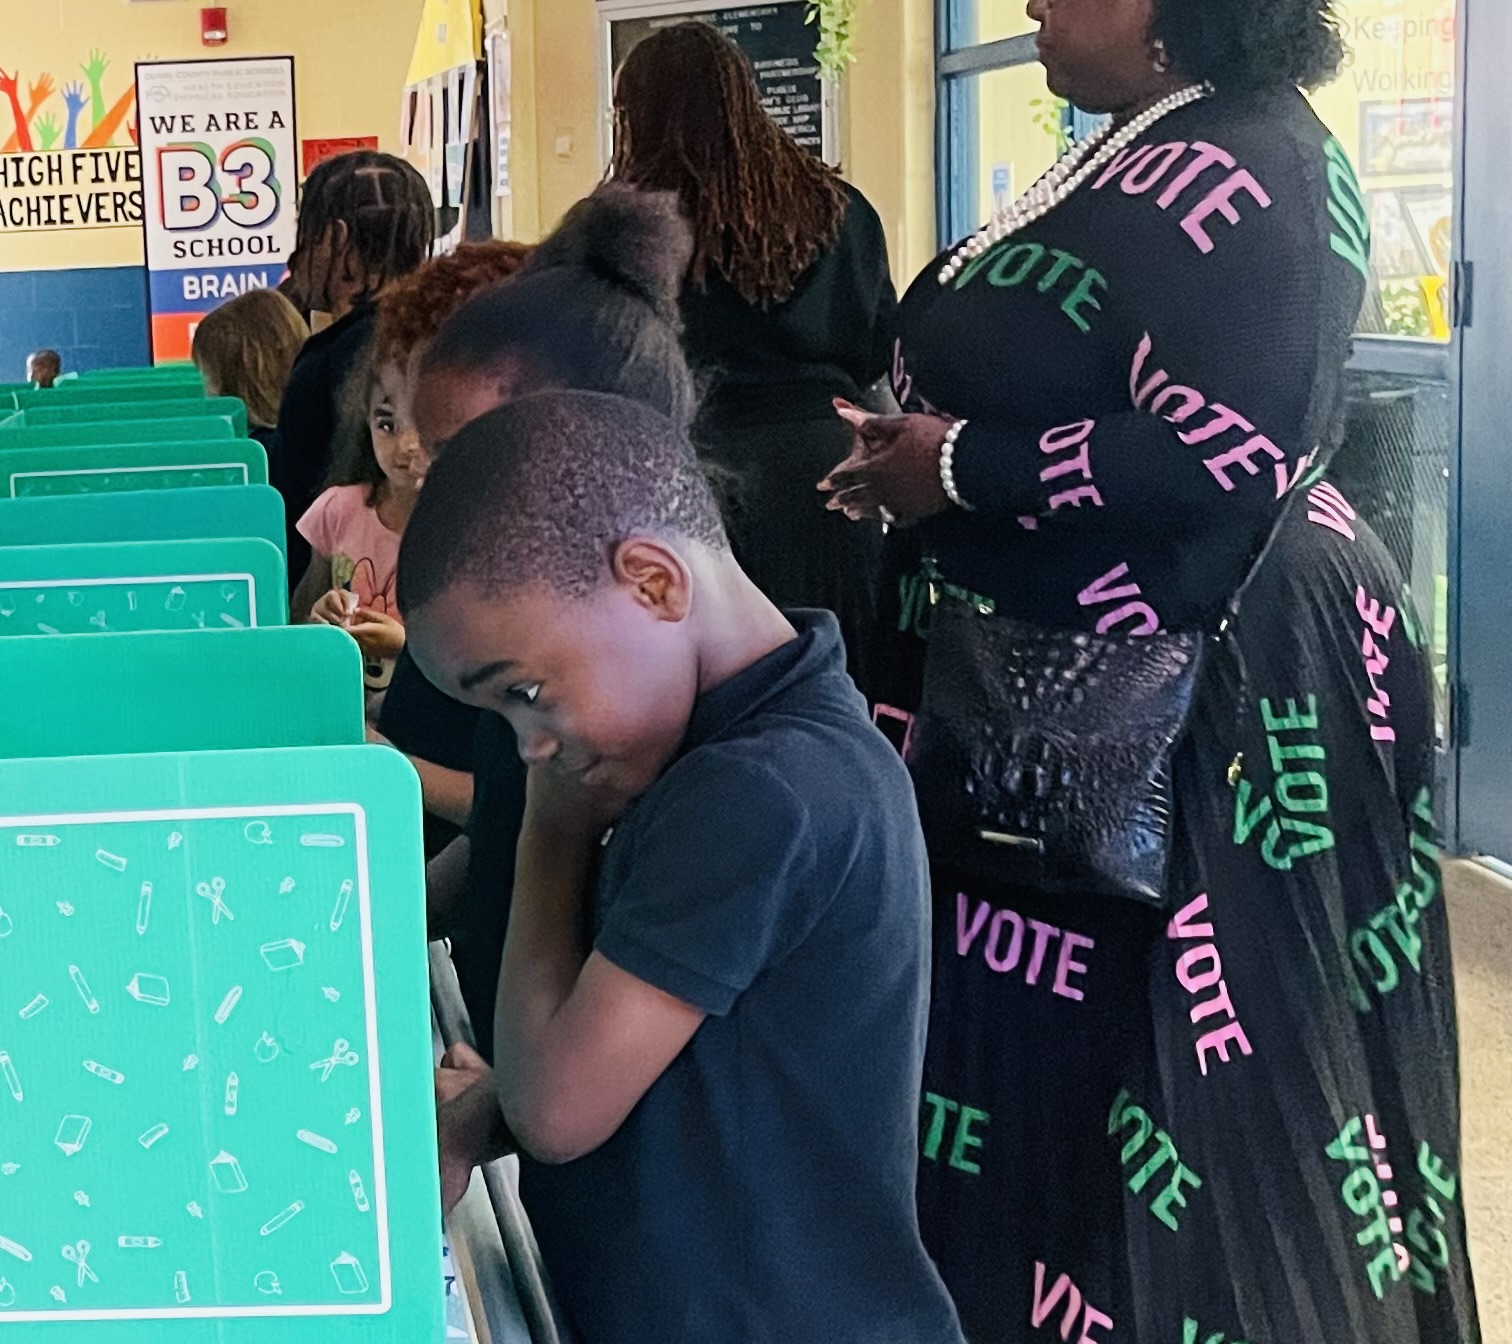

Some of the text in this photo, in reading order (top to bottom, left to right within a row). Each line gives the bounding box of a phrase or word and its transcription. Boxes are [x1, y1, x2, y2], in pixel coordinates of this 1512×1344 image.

[1354, 14, 1454, 42] Keping
[72, 150, 141, 184] FIVE
[149, 111, 286, 134] WE ARE A
[157, 136, 283, 232] B3
[1092, 141, 1271, 254] VOTE
[173, 234, 281, 259] SCHOOL
[183, 272, 268, 300] BRAIN
[955, 243, 1108, 331] VOTE
[1130, 331, 1288, 492] VOTE
[1039, 419, 1104, 508] OTE
[1260, 693, 1336, 859] VOTE
[956, 892, 1094, 1001] VOTE
[1168, 893, 1253, 1076] VOTE
[925, 1091, 989, 1175] TE
[1326, 1115, 1401, 1300] VOTE
